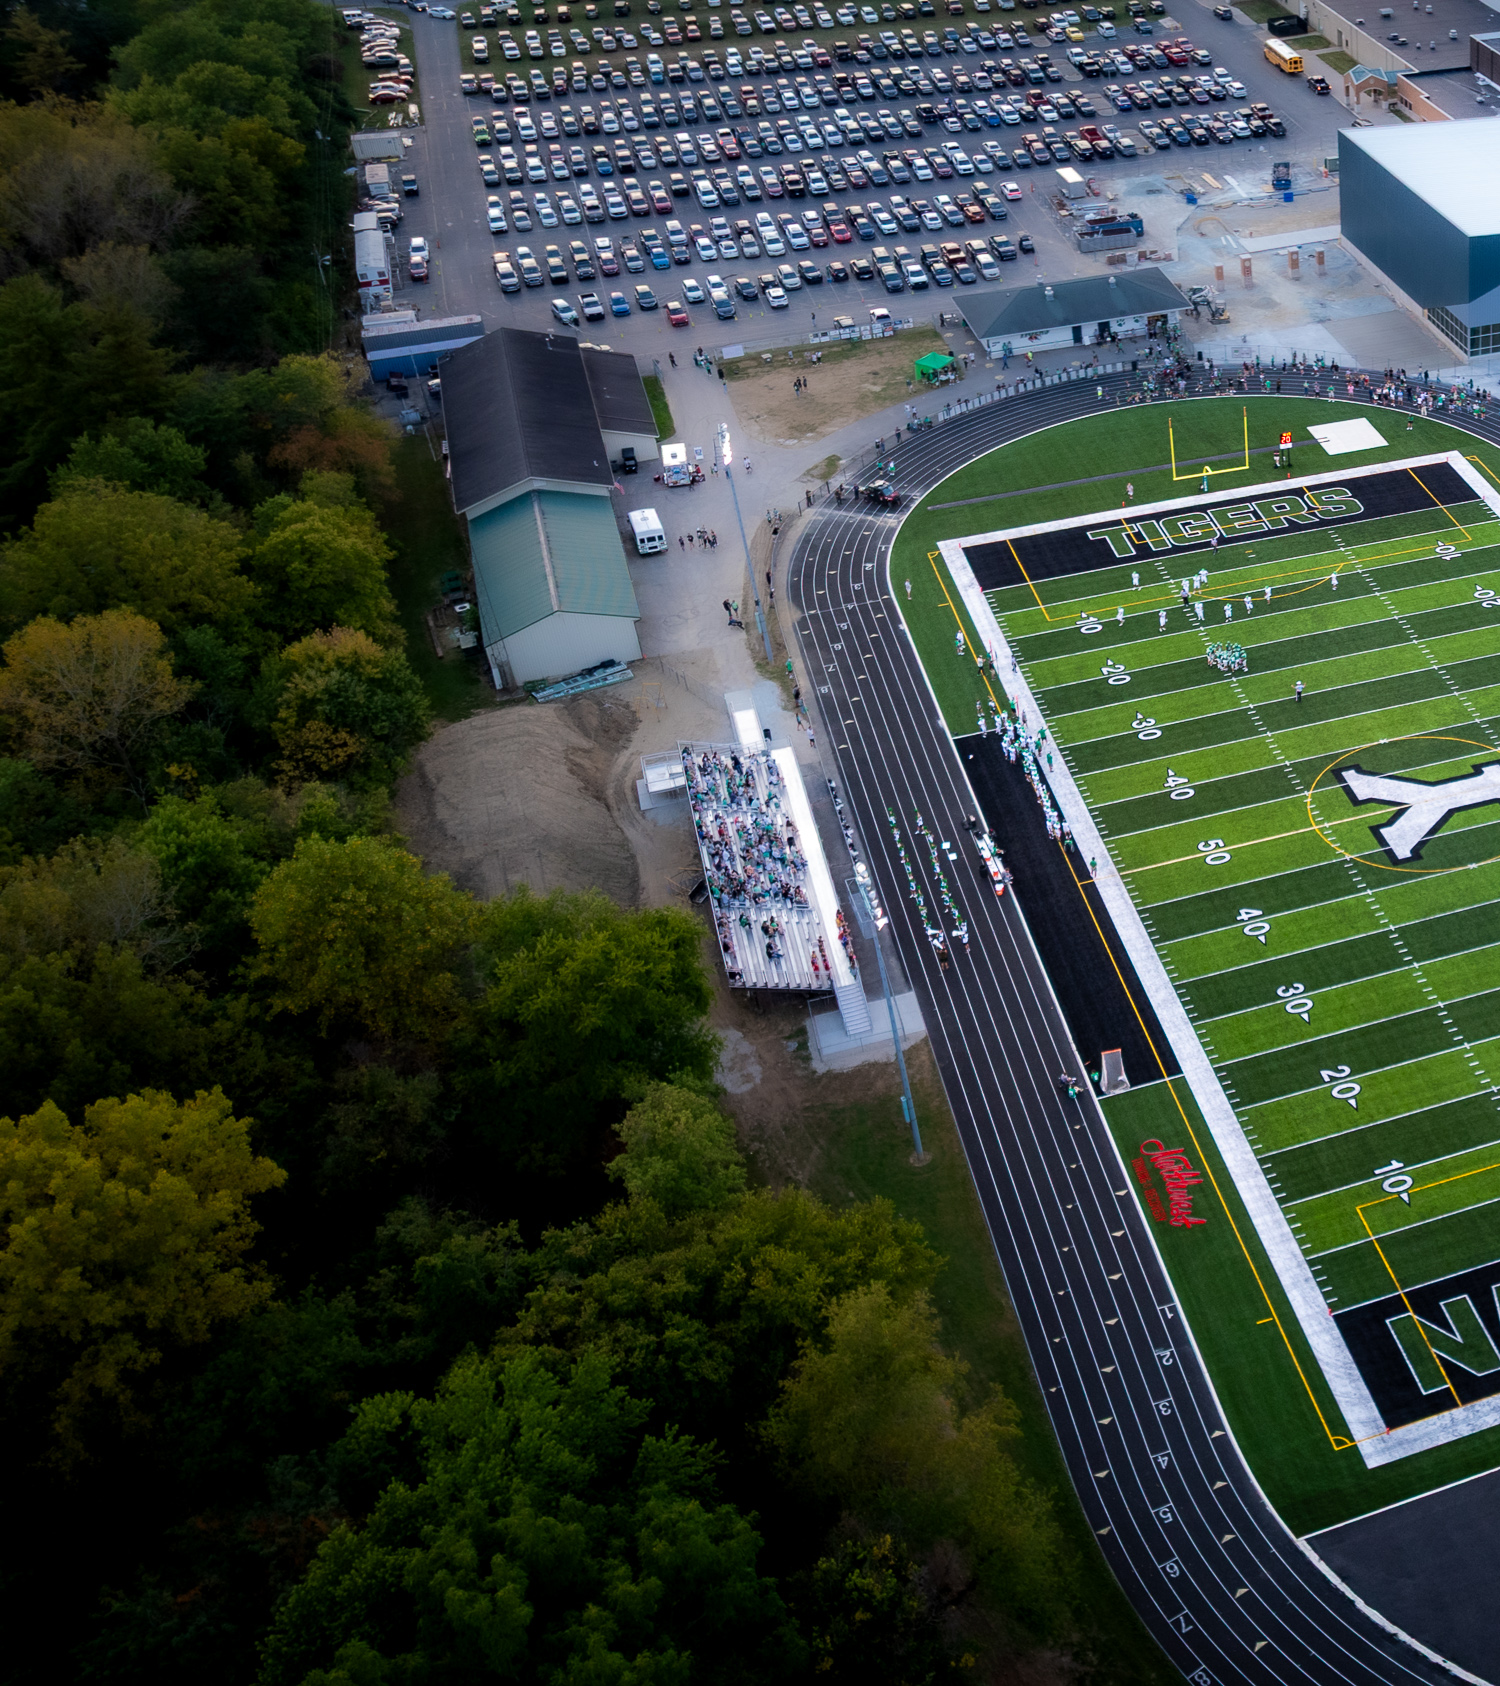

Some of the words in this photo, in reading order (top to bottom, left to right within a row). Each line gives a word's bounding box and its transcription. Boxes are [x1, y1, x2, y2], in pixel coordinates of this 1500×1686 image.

[1281, 436, 1291, 444] 20
[1086, 487, 1364, 557] TIGERS
[1435, 545, 1462, 561] 10
[1075, 616, 1103, 634] 10
[1100, 664, 1131, 685] 20
[1131, 718, 1162, 740] 30
[1163, 777, 1195, 800] 40
[1197, 838, 1231, 865] 50
[1235, 908, 1271, 936] 40
[1276, 983, 1314, 1014] 30
[1319, 1065, 1361, 1099] 20
[1140, 1138, 1207, 1229] Northwest
[1373, 1159, 1413, 1193] 10
[1164, 1307, 1174, 1319] 1
[1160, 1352, 1173, 1366] 2
[1159, 1402, 1171, 1416] 3
[1157, 1456, 1169, 1470] 4
[1159, 1508, 1173, 1524] 5
[1166, 1562, 1180, 1578] 6
[1179, 1616, 1193, 1634] 7
